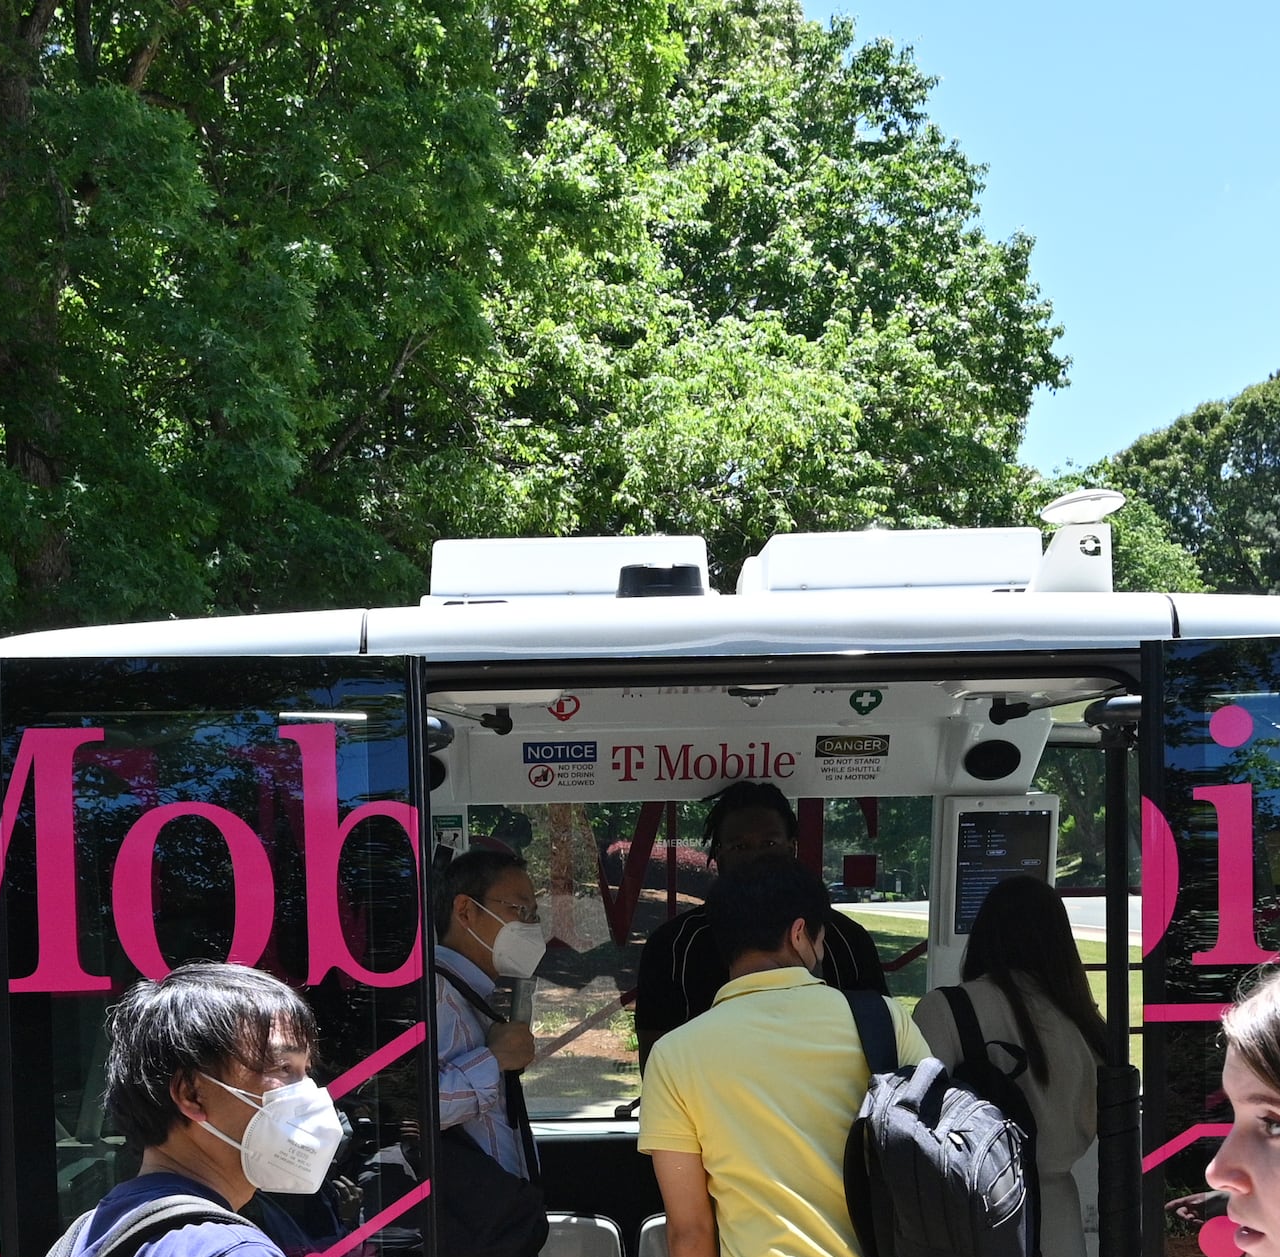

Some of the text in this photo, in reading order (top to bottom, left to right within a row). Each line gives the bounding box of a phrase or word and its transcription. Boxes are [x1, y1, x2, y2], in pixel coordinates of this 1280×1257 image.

[824, 740, 882, 752] DANGER
[527, 745, 595, 760] NOTICE
[654, 741, 796, 781] Mobile
[558, 763, 570, 771] NO
[557, 779, 595, 787] ALLOWED
[655, 837, 713, 848] EMERGENY
